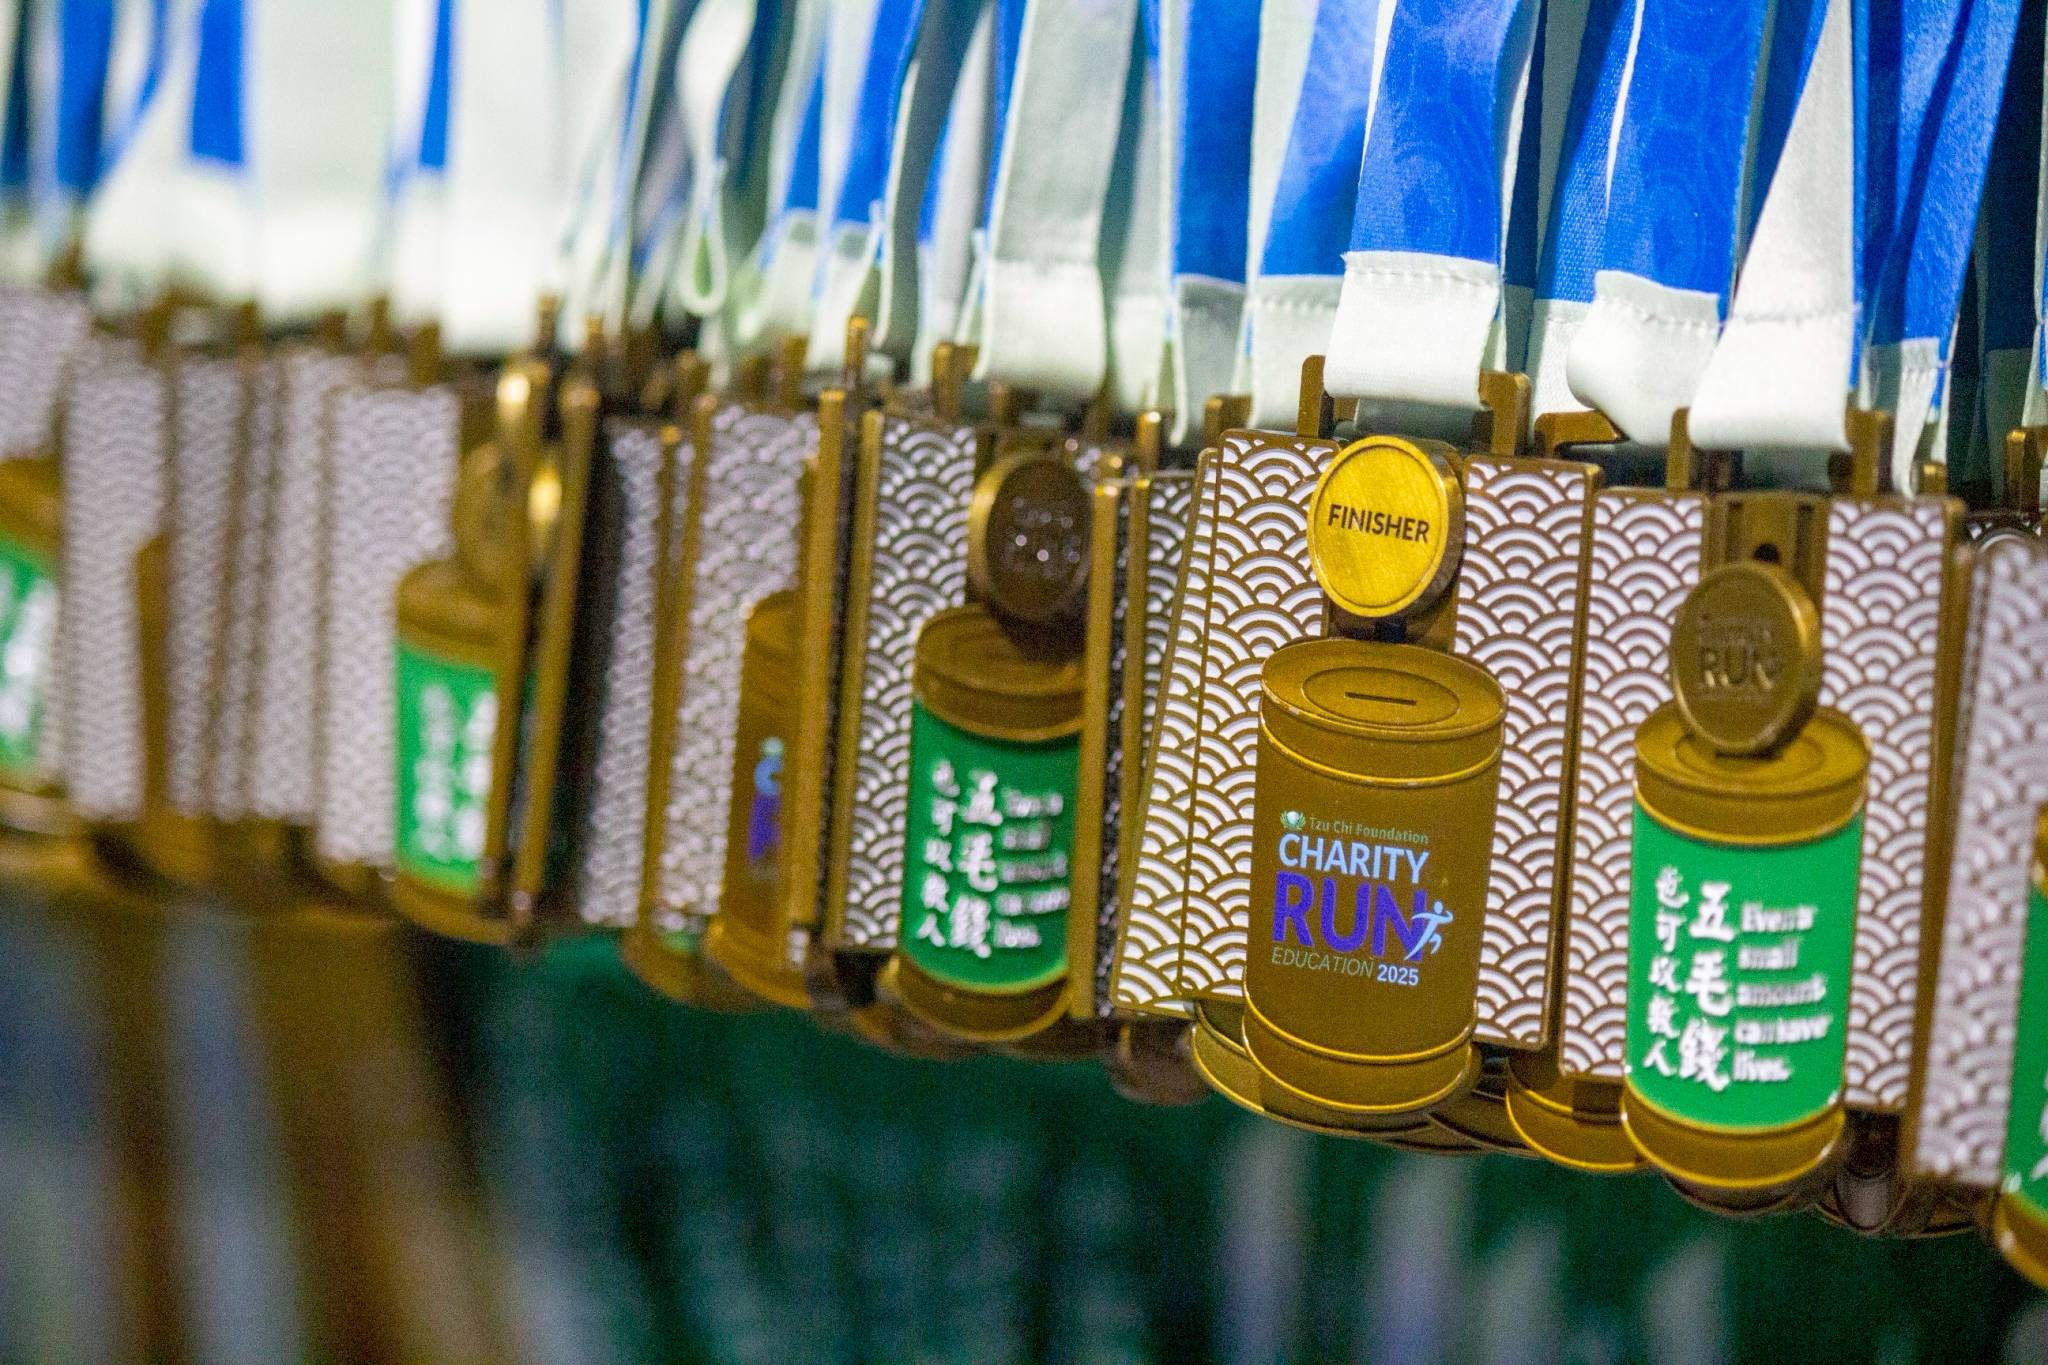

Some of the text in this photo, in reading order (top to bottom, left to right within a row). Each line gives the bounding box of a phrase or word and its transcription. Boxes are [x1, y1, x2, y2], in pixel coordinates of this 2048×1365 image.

[1327, 503, 1430, 544] FINISHER
[1310, 816, 1430, 845] Tzu Chi Foundation
[1279, 832, 1430, 885] CHARITY
[1272, 870, 1429, 963] RUN
[1271, 946, 1420, 987] EDUCATION 2025
[1679, 881, 1736, 1092] 五毛錢
